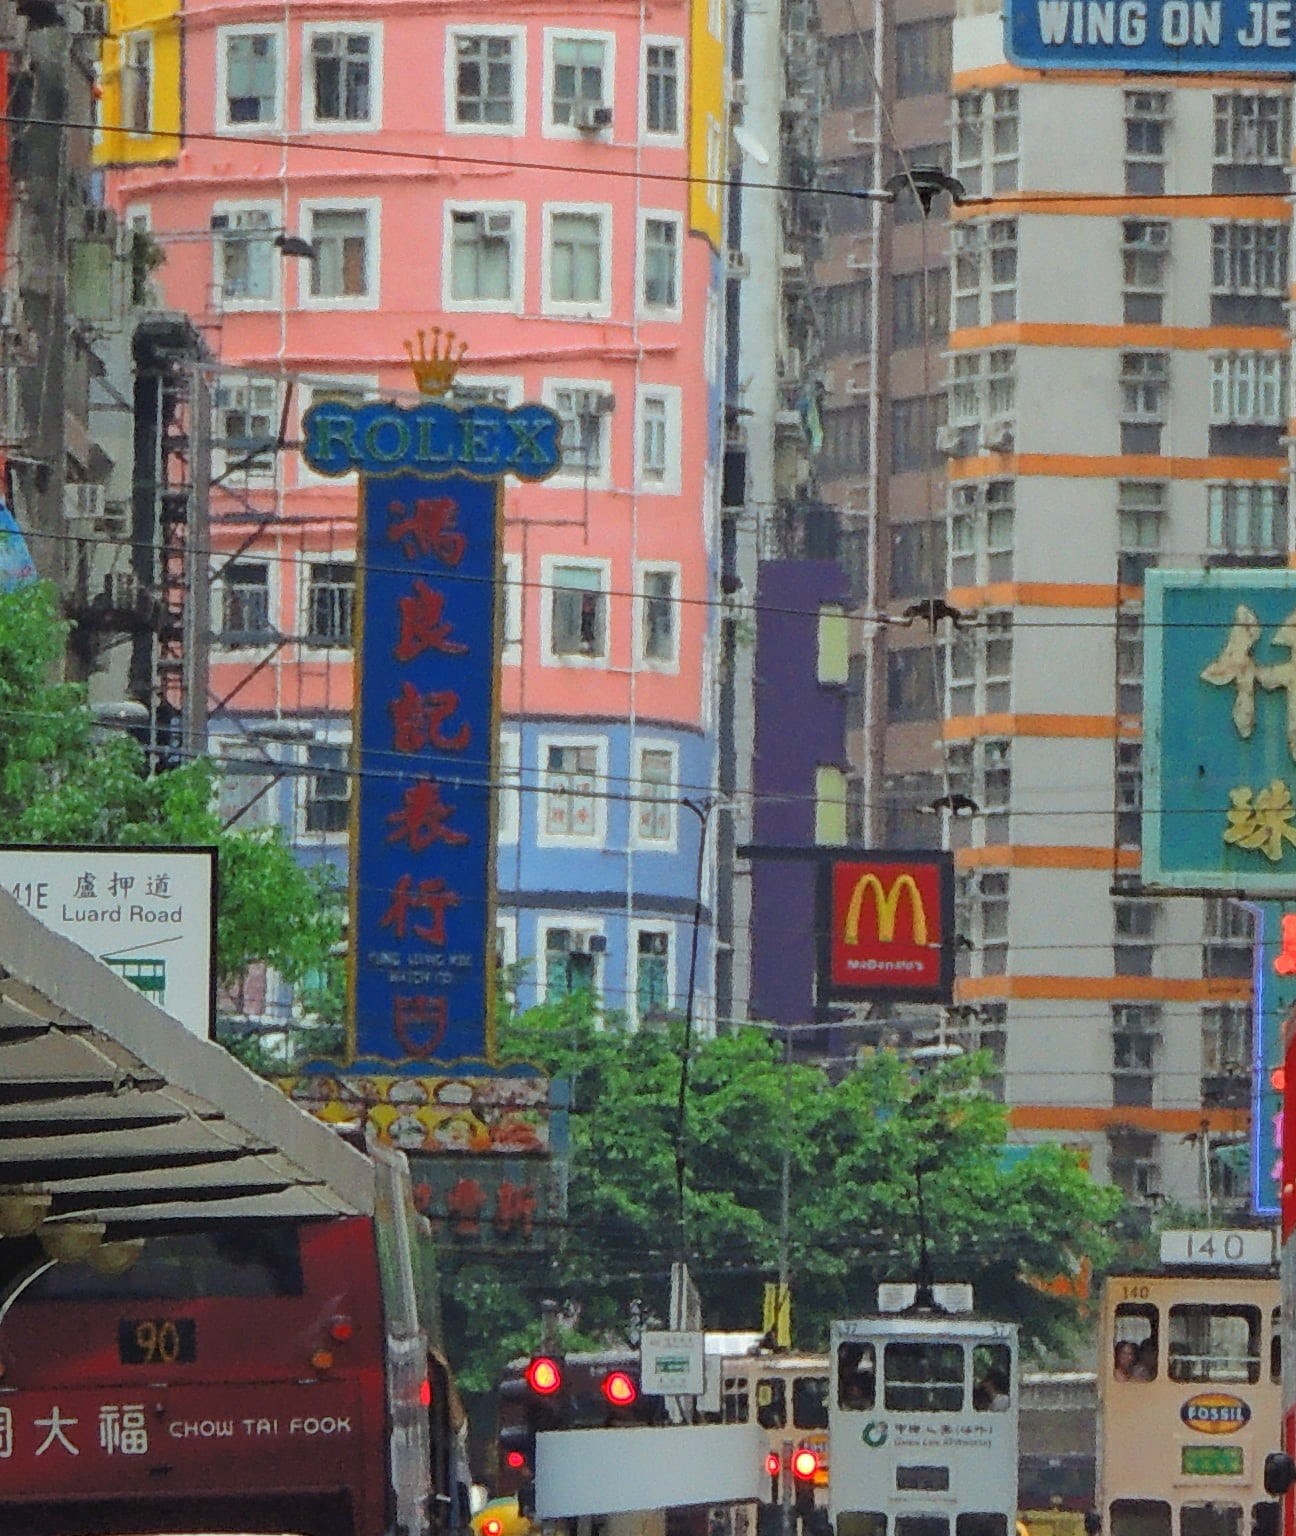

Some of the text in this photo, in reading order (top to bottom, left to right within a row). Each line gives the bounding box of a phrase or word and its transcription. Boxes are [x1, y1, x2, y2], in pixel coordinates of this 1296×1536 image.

[1038, 0, 1147, 46] WING
[1162, 0, 1222, 47] ON
[313, 414, 553, 462] ROLEX
[74, 871, 172, 900] 盧押道
[62, 904, 182, 923] Luard Road
[1186, 1234, 1244, 1261] 140
[1122, 1287, 1149, 1300] 140
[136, 1321, 180, 1363] 90
[1188, 1405, 1244, 1421] FOSSIL
[170, 1417, 351, 1439] CHOW TAI FOOK
